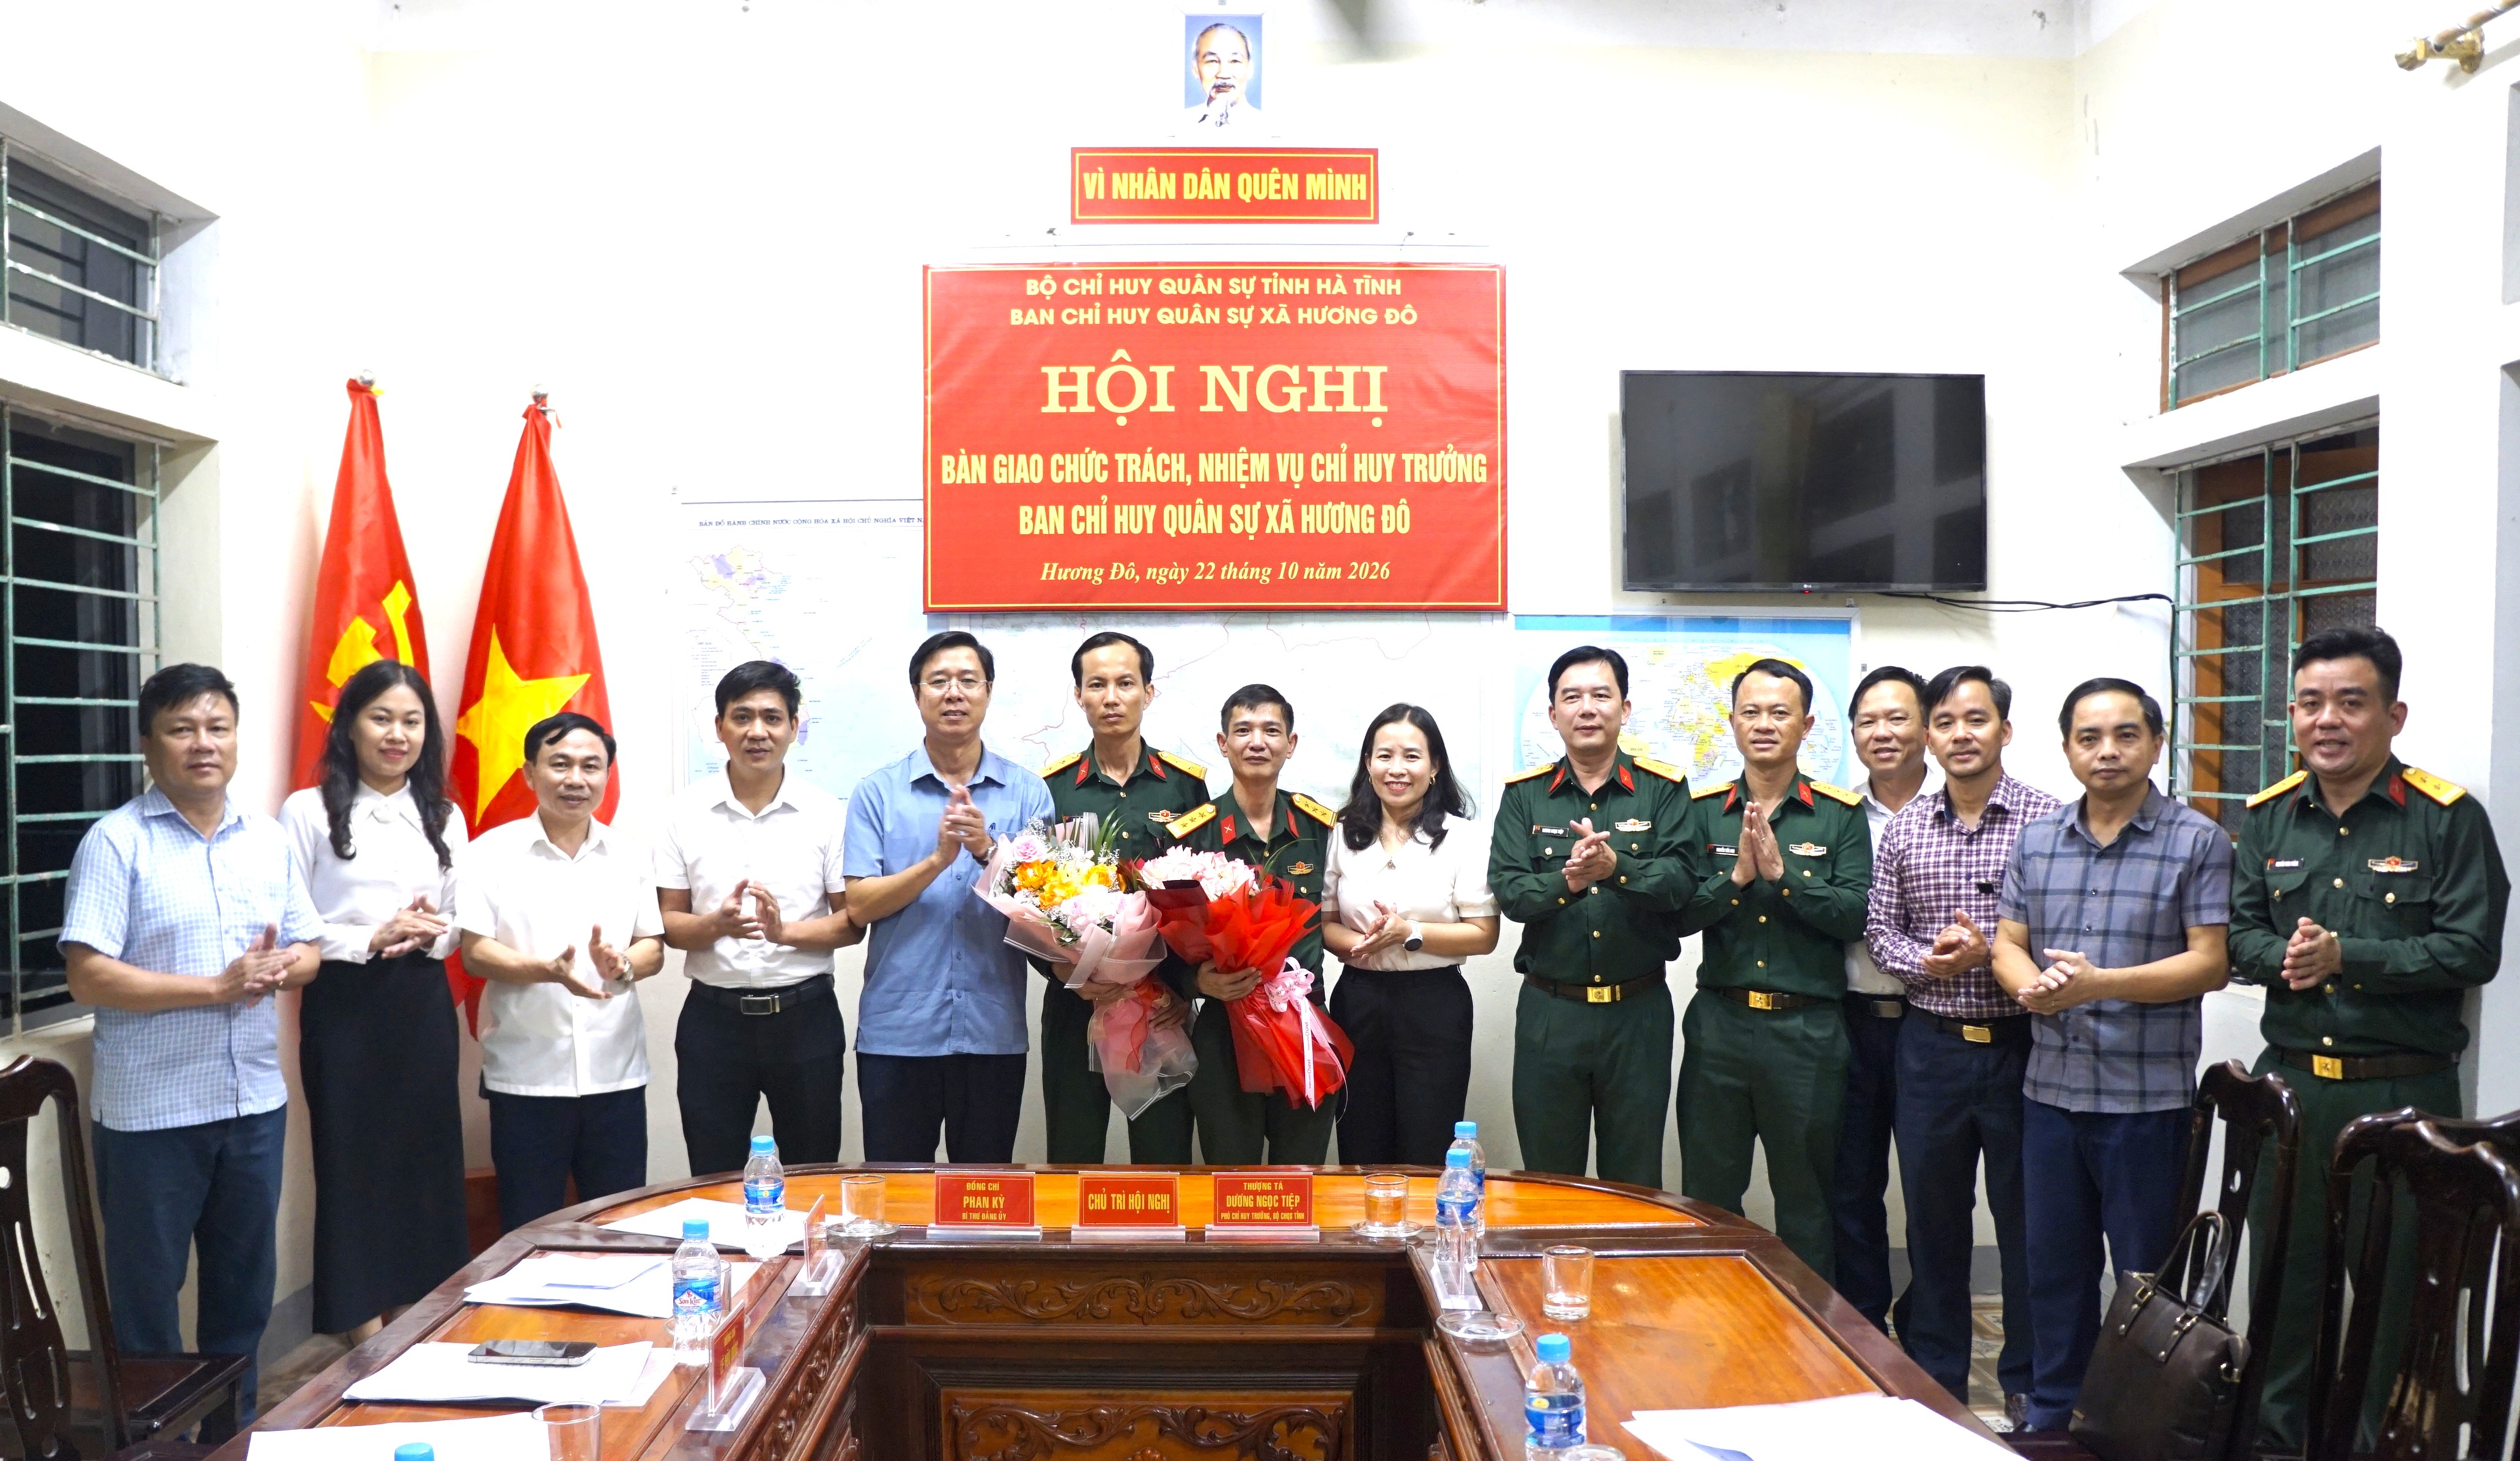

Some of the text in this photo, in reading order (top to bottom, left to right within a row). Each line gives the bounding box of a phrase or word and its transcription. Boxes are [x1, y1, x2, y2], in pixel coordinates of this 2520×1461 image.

[1084, 171, 1367, 202] VÌ NHÂN DÂN QUÊN MÌNH
[1025, 271, 1401, 300] BỘ CHỈ HUY QUÂN SỰ TỈNH HÀ TĨNH
[1010, 301, 1419, 329] BAN CHỈ HUY QUÂN SỰ XÃ HƯƠNG ĐÔ
[1041, 349, 1388, 427] HỘI NGHỊ
[942, 442, 1487, 489] BÀN GIAO CHỨC TRÁCH, NHIỆM VỤ CHỈ HUY TRƯỞNG
[1019, 494, 1410, 540] BAN CHỈ HUY QUÂN SỰ XÃ HƯƠNG ĐÔ
[1040, 561, 1390, 585] Hương Đô, ngày 22 tháng 10 năm 2026
[966, 1180, 1000, 1191] ĐỒNG CHÍ
[1243, 1181, 1283, 1192] THƯỢNG TÁ
[963, 1194, 1005, 1208] PHAN KỲ
[1088, 1188, 1169, 1213] CHỦ TRÌ HỘI NGHỊ
[1226, 1193, 1299, 1210] DƯƠNG NGỌC TIỆP
[962, 1211, 1006, 1220] BÍ THƯ ĐẢNG ỦY
[1273, 1211, 1279, 1221] BỘ
[1280, 1212, 1293, 1221] CHQS
